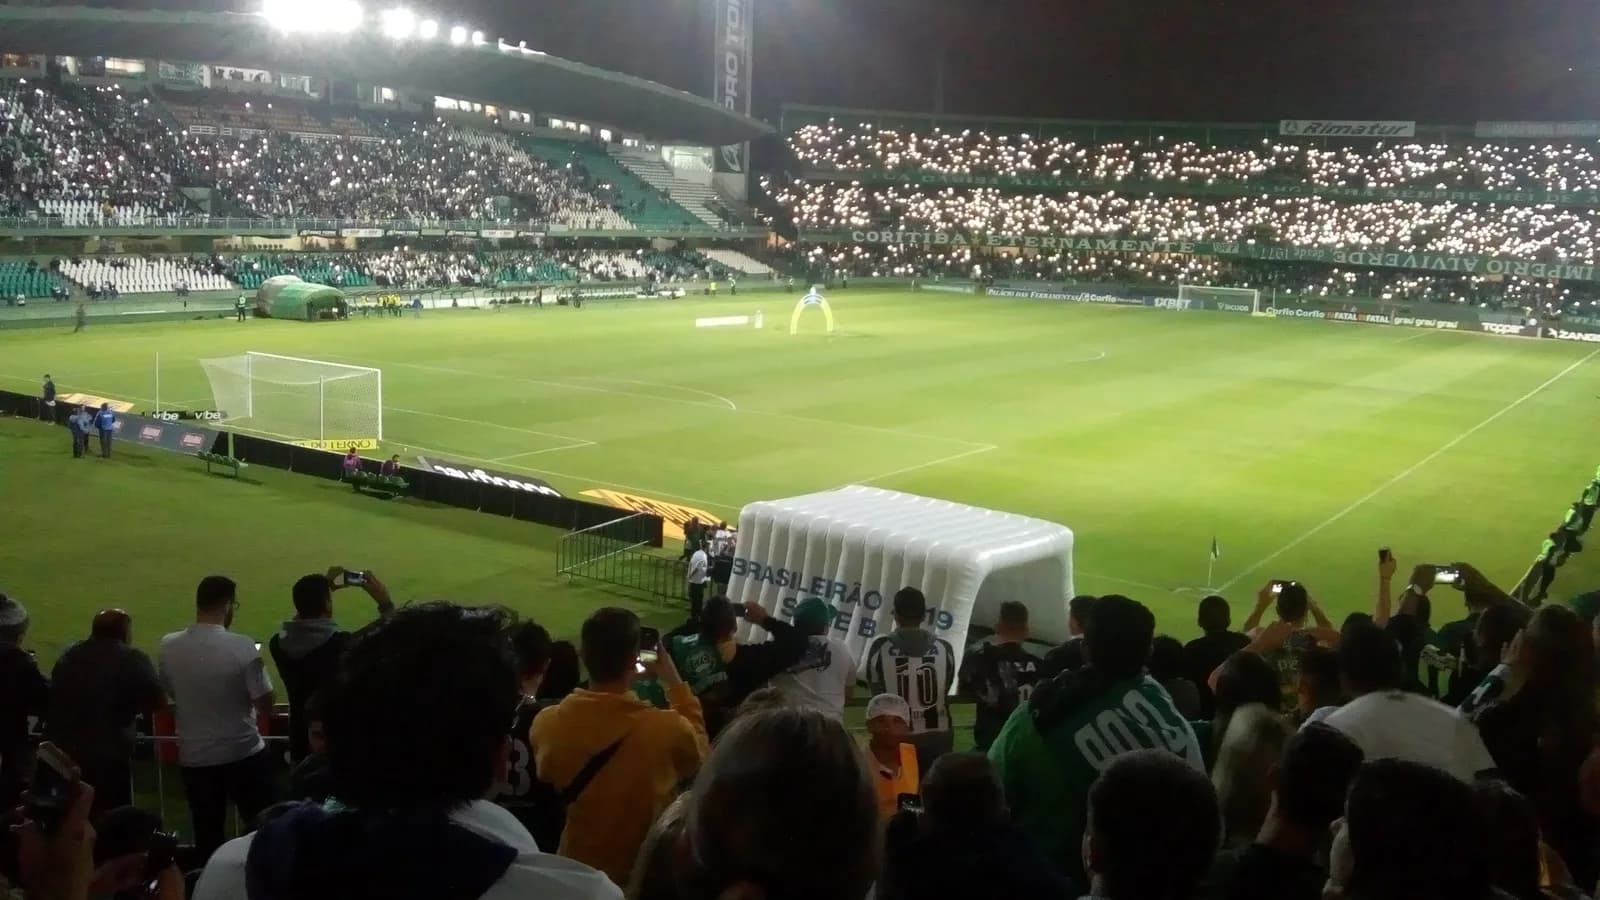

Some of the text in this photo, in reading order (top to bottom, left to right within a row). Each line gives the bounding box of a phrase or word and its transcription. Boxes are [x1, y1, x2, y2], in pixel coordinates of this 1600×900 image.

[1303, 122, 1409, 135] Rimatur
[852, 230, 967, 245] CORITIBA
[987, 234, 1195, 253] ETERNAMENTE
[1293, 248, 1325, 261] desde
[1333, 250, 1479, 273] ALVIVERDE
[1334, 311, 1391, 323] FATAL FATAL
[195, 410, 221, 420] vibe
[732, 557, 882, 611] BRASILEIRÃO
[858, 616, 877, 638] B
